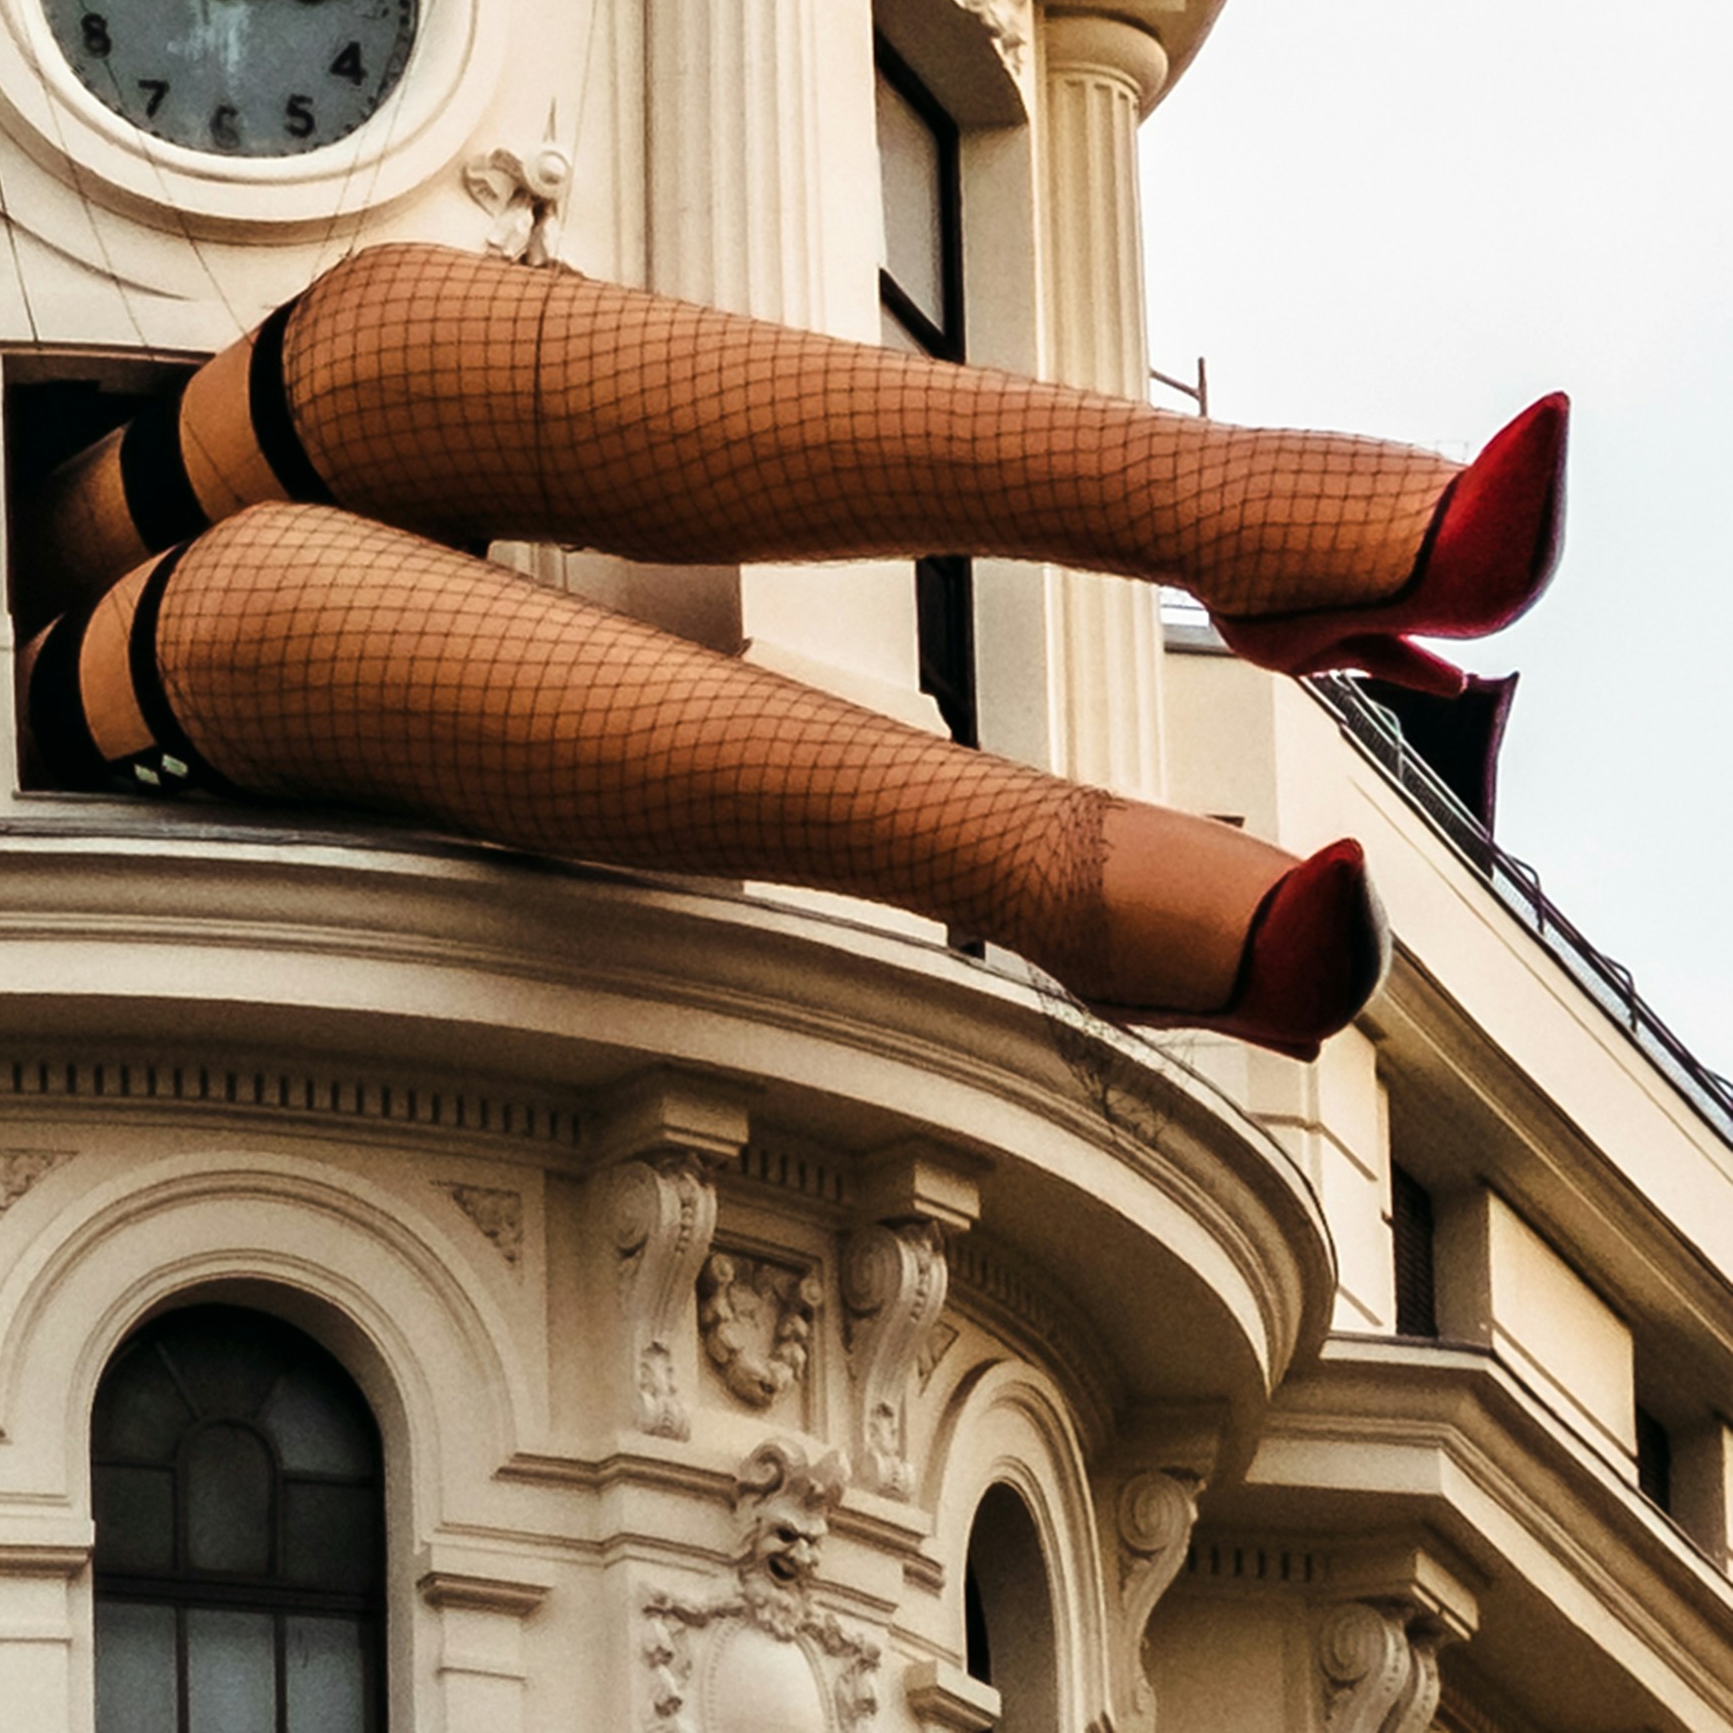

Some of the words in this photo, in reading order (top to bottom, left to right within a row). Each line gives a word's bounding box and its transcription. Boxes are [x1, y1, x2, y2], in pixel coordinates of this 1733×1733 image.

[81, 12, 112, 58] 8
[329, 41, 367, 86] 4
[138, 80, 169, 118] 7
[285, 94, 315, 138] 5
